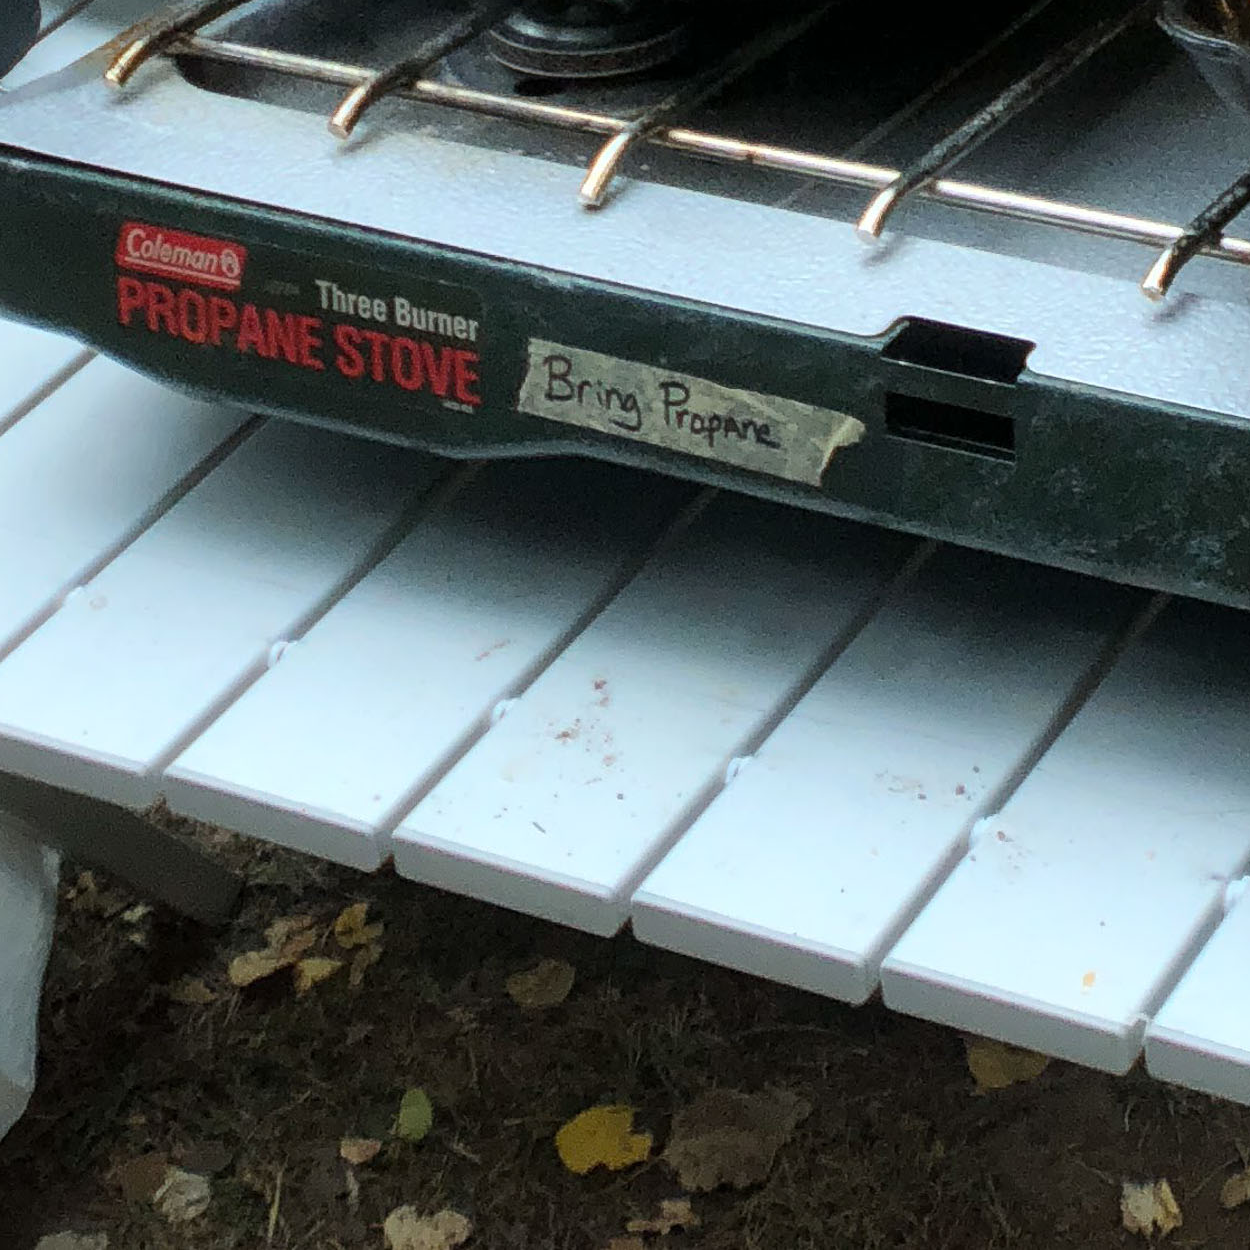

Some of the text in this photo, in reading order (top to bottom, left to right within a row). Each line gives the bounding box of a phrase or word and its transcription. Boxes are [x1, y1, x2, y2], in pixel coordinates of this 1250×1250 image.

[126, 228, 220, 275] Coleman
[115, 274, 482, 407] PROPANE STOVE
[314, 278, 480, 342] Three Burner
[543, 353, 781, 448] Bring Propane
